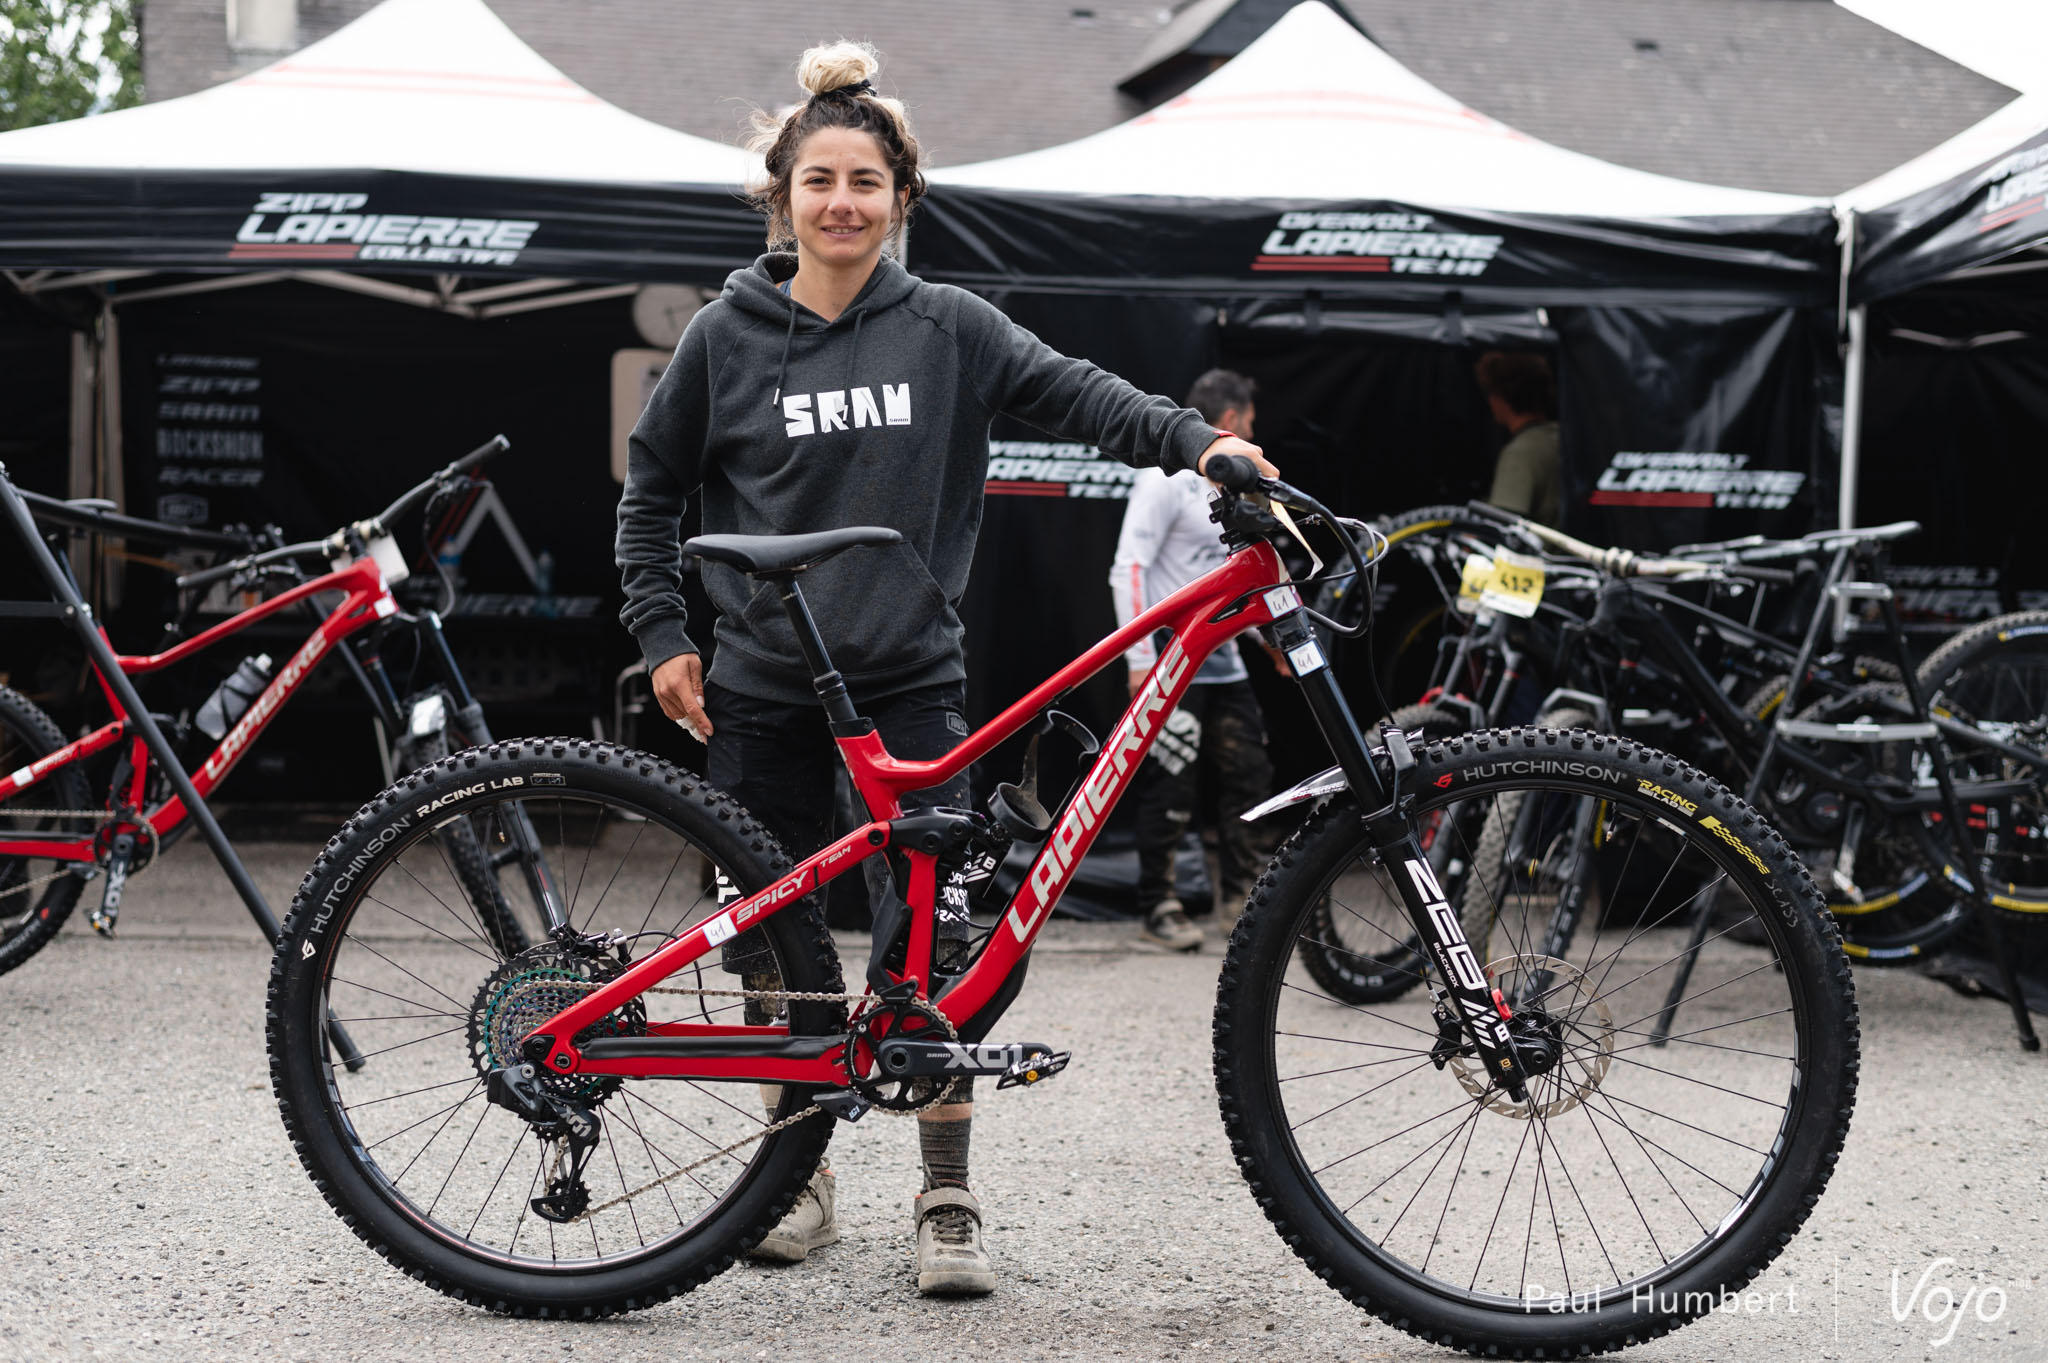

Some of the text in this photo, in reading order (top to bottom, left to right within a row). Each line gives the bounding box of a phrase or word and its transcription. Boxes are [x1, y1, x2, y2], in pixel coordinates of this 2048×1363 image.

[253, 193, 368, 213] ZIPP
[236, 214, 540, 250] LAPIERRE
[1277, 211, 1434, 231] OVERVOLT
[359, 245, 520, 266] COLLECTIVE
[1261, 230, 1504, 260] LAPIERRE
[1391, 257, 1488, 276] TEAM
[782, 383, 912, 438] SRAM
[1597, 467, 1806, 494] LAPIERRE
[205, 628, 328, 780] LAPIERRE
[415, 776, 525, 818] RACING LAB
[1006, 636, 1190, 943] LAPIERRE
[1637, 779, 1699, 812] RACING
[819, 845, 852, 868] TEAM
[309, 813, 412, 935] HUTCHINSON
[736, 869, 808, 925] SPICY
[1432, 942, 1460, 988] BLACKBOX
